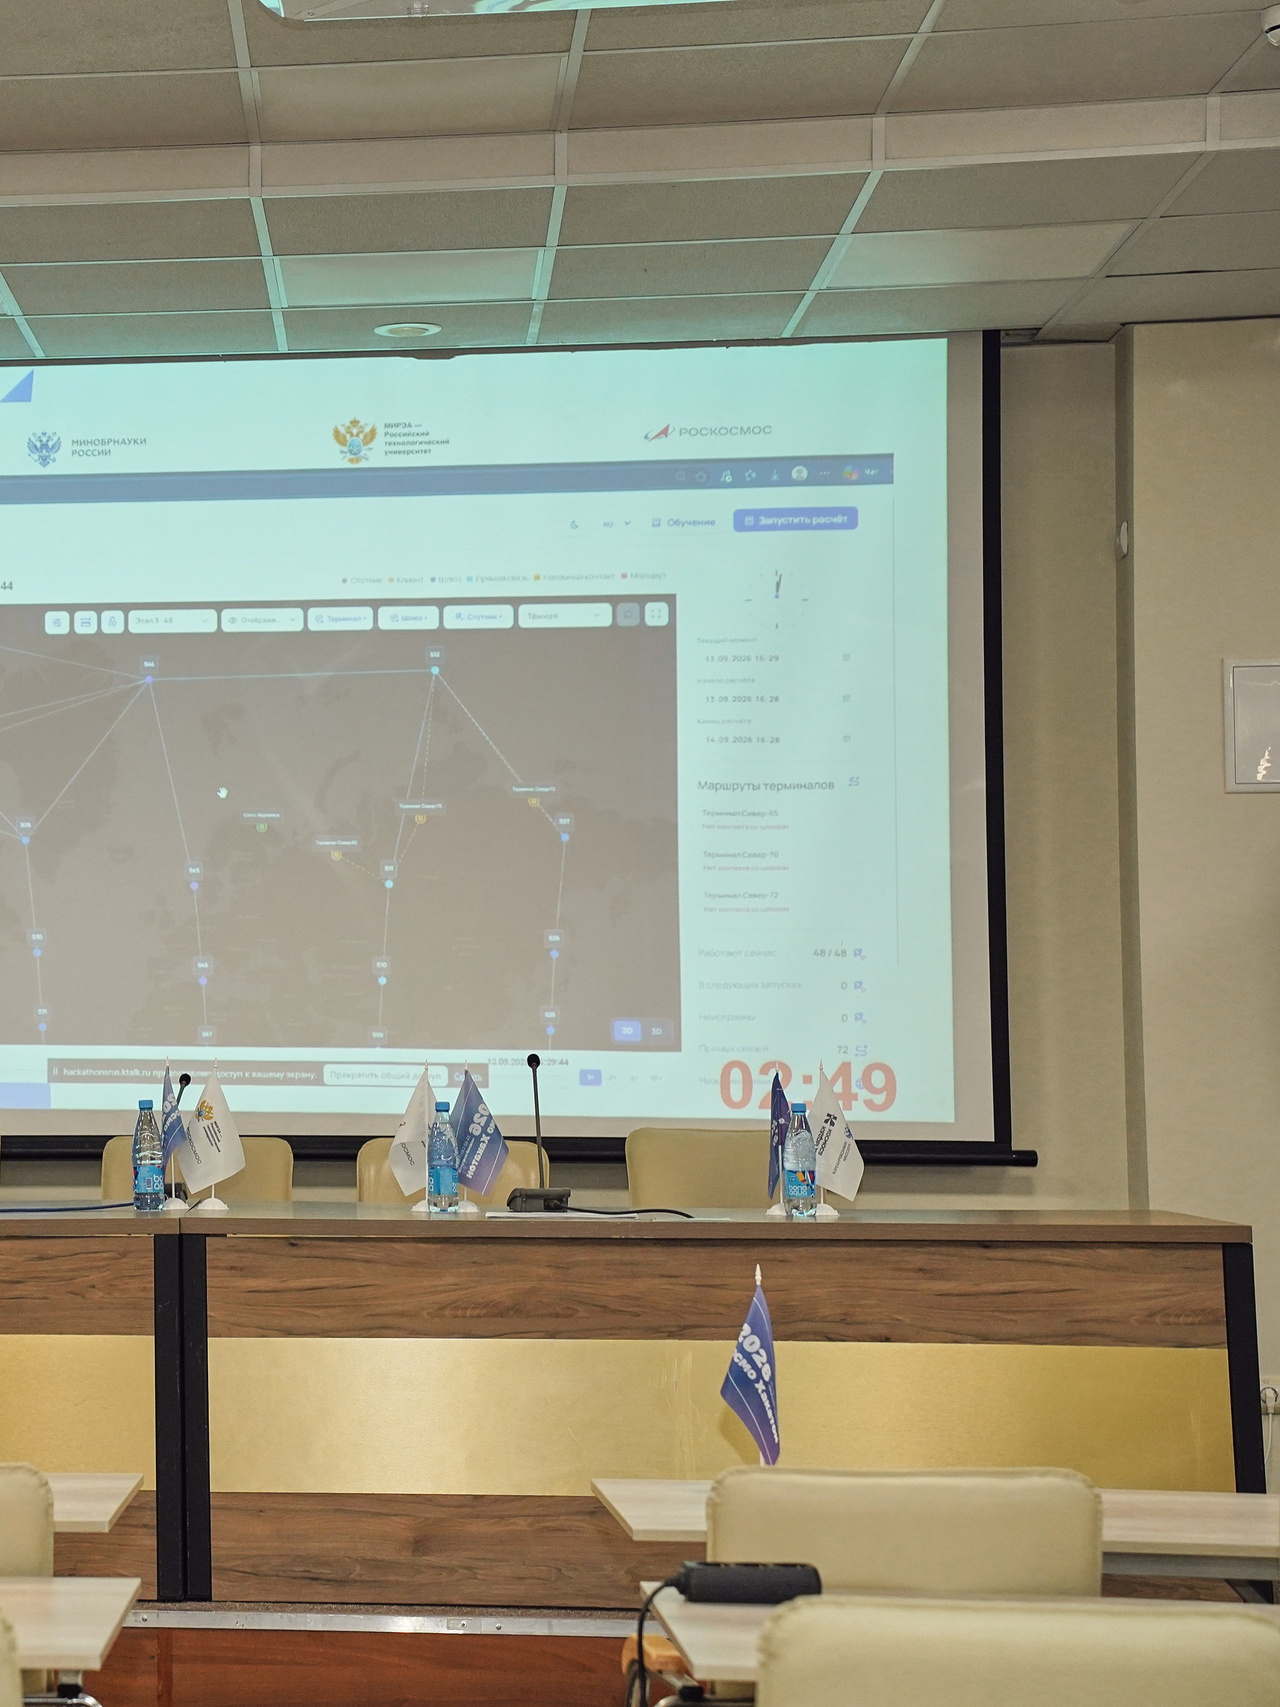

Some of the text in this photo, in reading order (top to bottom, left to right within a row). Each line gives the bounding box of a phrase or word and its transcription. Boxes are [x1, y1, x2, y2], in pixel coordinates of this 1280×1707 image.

[384, 421, 413, 429] МИРЭА
[384, 430, 430, 438] Российский
[679, 424, 773, 438] РОСКОСМОС
[71, 437, 147, 447] МИНОБРНАУКИ
[384, 437, 450, 446] технологический
[71, 448, 111, 457] РОССИИ
[384, 448, 432, 457] университет
[667, 517, 716, 529] Обучение
[758, 513, 848, 526] Запустить расчёт
[698, 780, 835, 792] Маршруты терминалов
[698, 949, 776, 957] Работают сейчас
[813, 949, 826, 957] 48
[834, 949, 847, 957] 48
[837, 1046, 848, 1054] 72
[487, 1058, 527, 1066] 13.09.202
[251, 1072, 285, 1080] вашему
[738, 1323, 771, 1382] 2026
